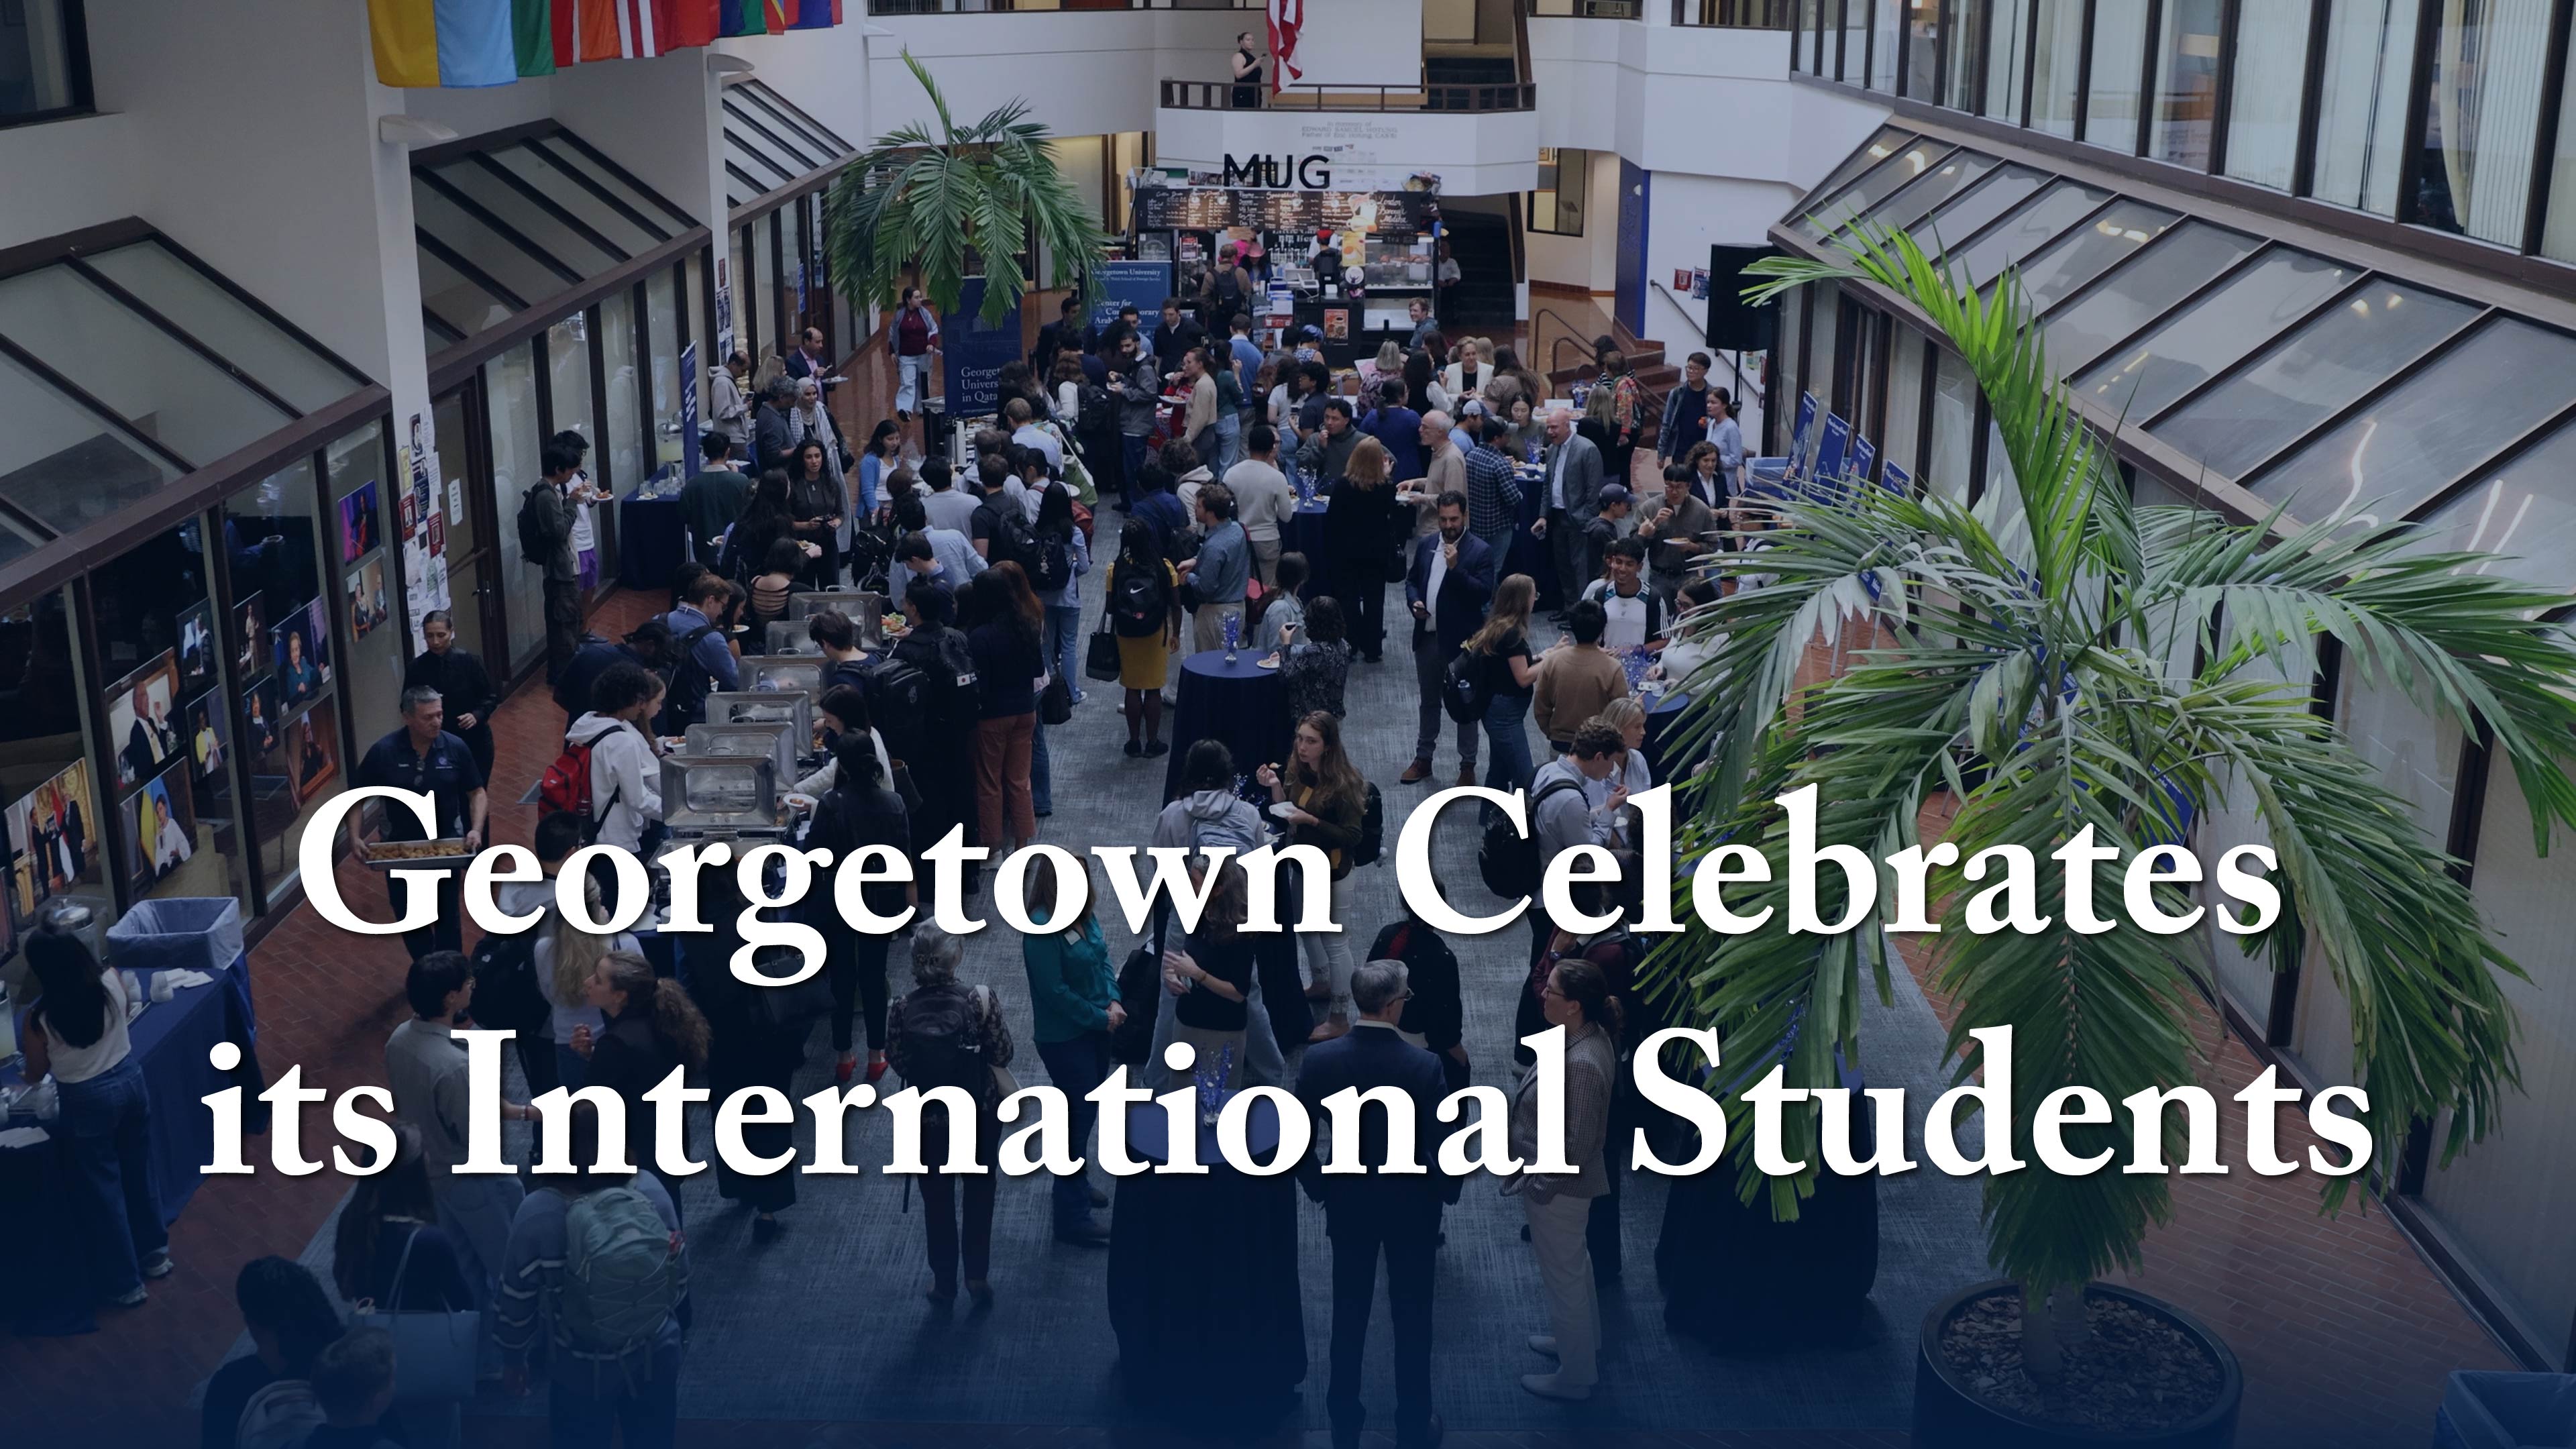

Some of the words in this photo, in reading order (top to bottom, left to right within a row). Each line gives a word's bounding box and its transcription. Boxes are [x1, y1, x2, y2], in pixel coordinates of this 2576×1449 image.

[1224, 154, 1330, 189] MUG
[1130, 268, 1161, 276] University
[1120, 299, 1132, 309] for
[961, 366, 1000, 379] Georget
[961, 379, 998, 390] Univers
[962, 392, 971, 402] in
[974, 390, 998, 403] Qata
